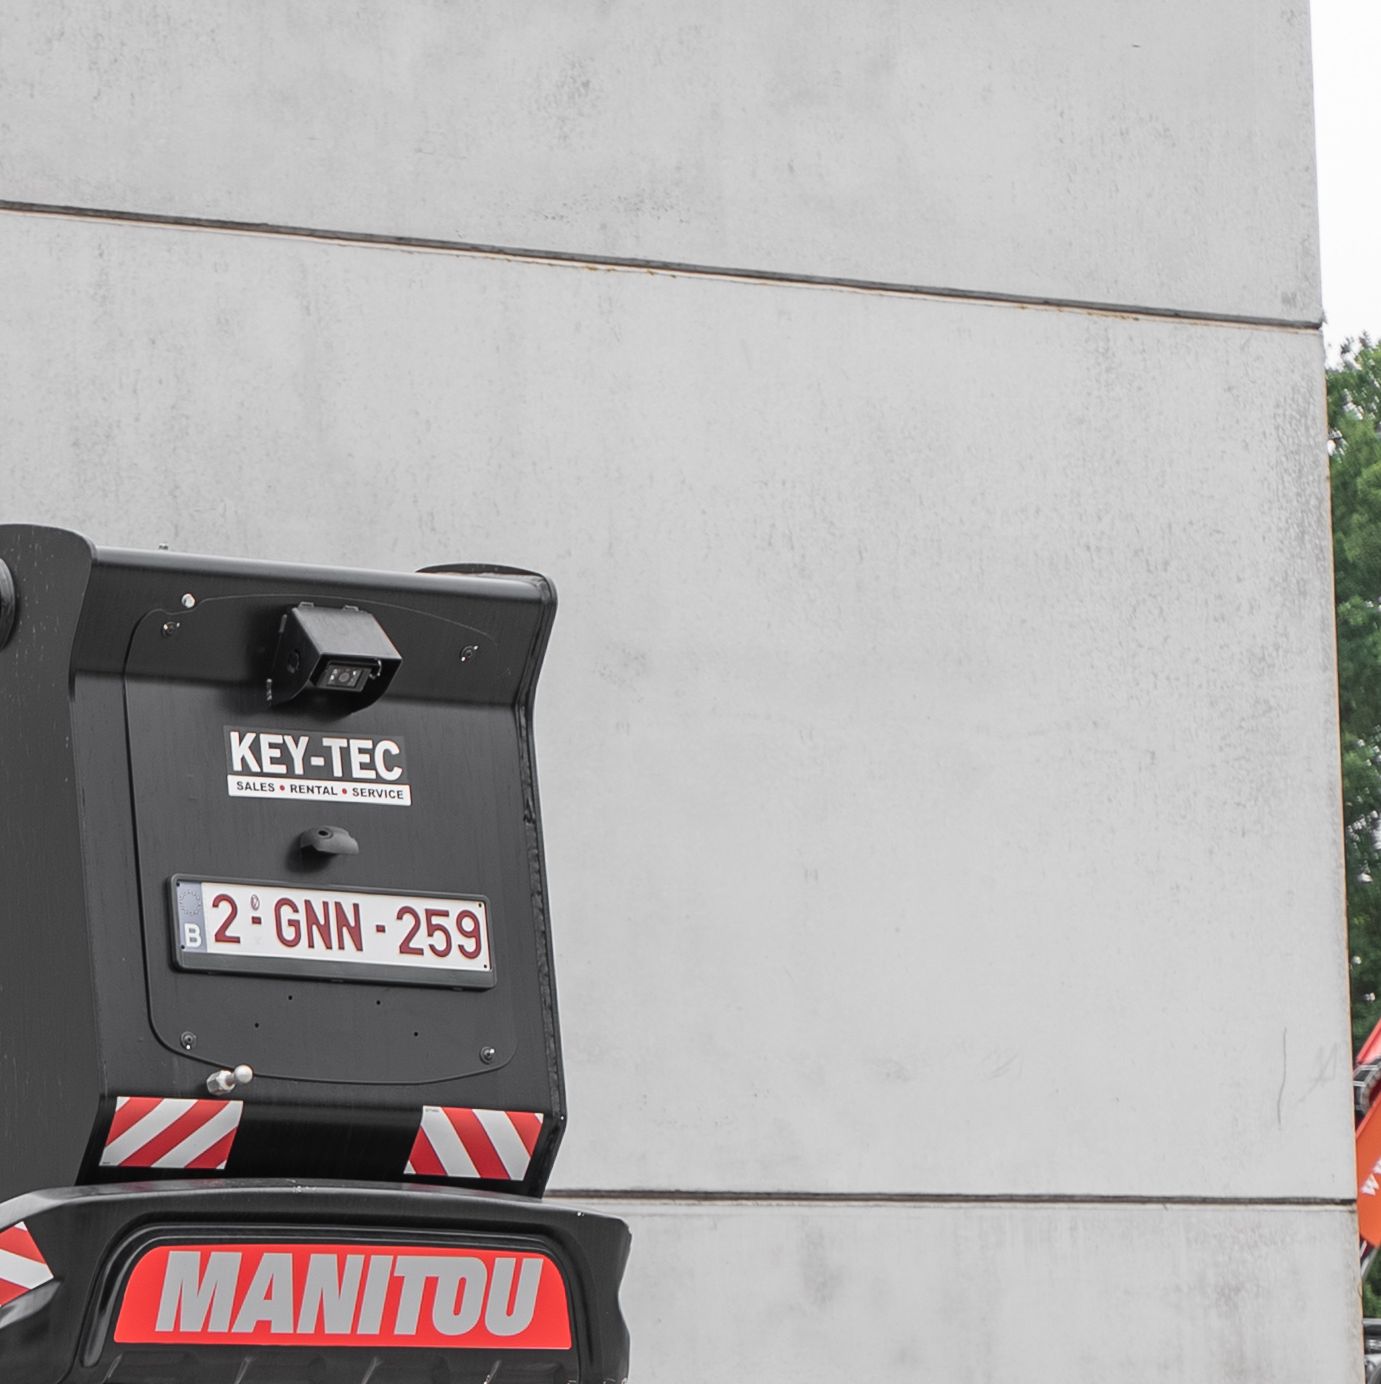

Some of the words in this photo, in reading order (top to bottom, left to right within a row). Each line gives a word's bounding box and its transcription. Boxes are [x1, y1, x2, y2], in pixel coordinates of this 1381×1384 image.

[230, 731, 403, 781] KEY-TEC
[236, 781, 275, 793] SALES
[290, 784, 338, 796] RENTAL
[352, 787, 404, 800] SERVICE
[184, 923, 202, 948] B
[155, 1250, 544, 1336] MANITOU
